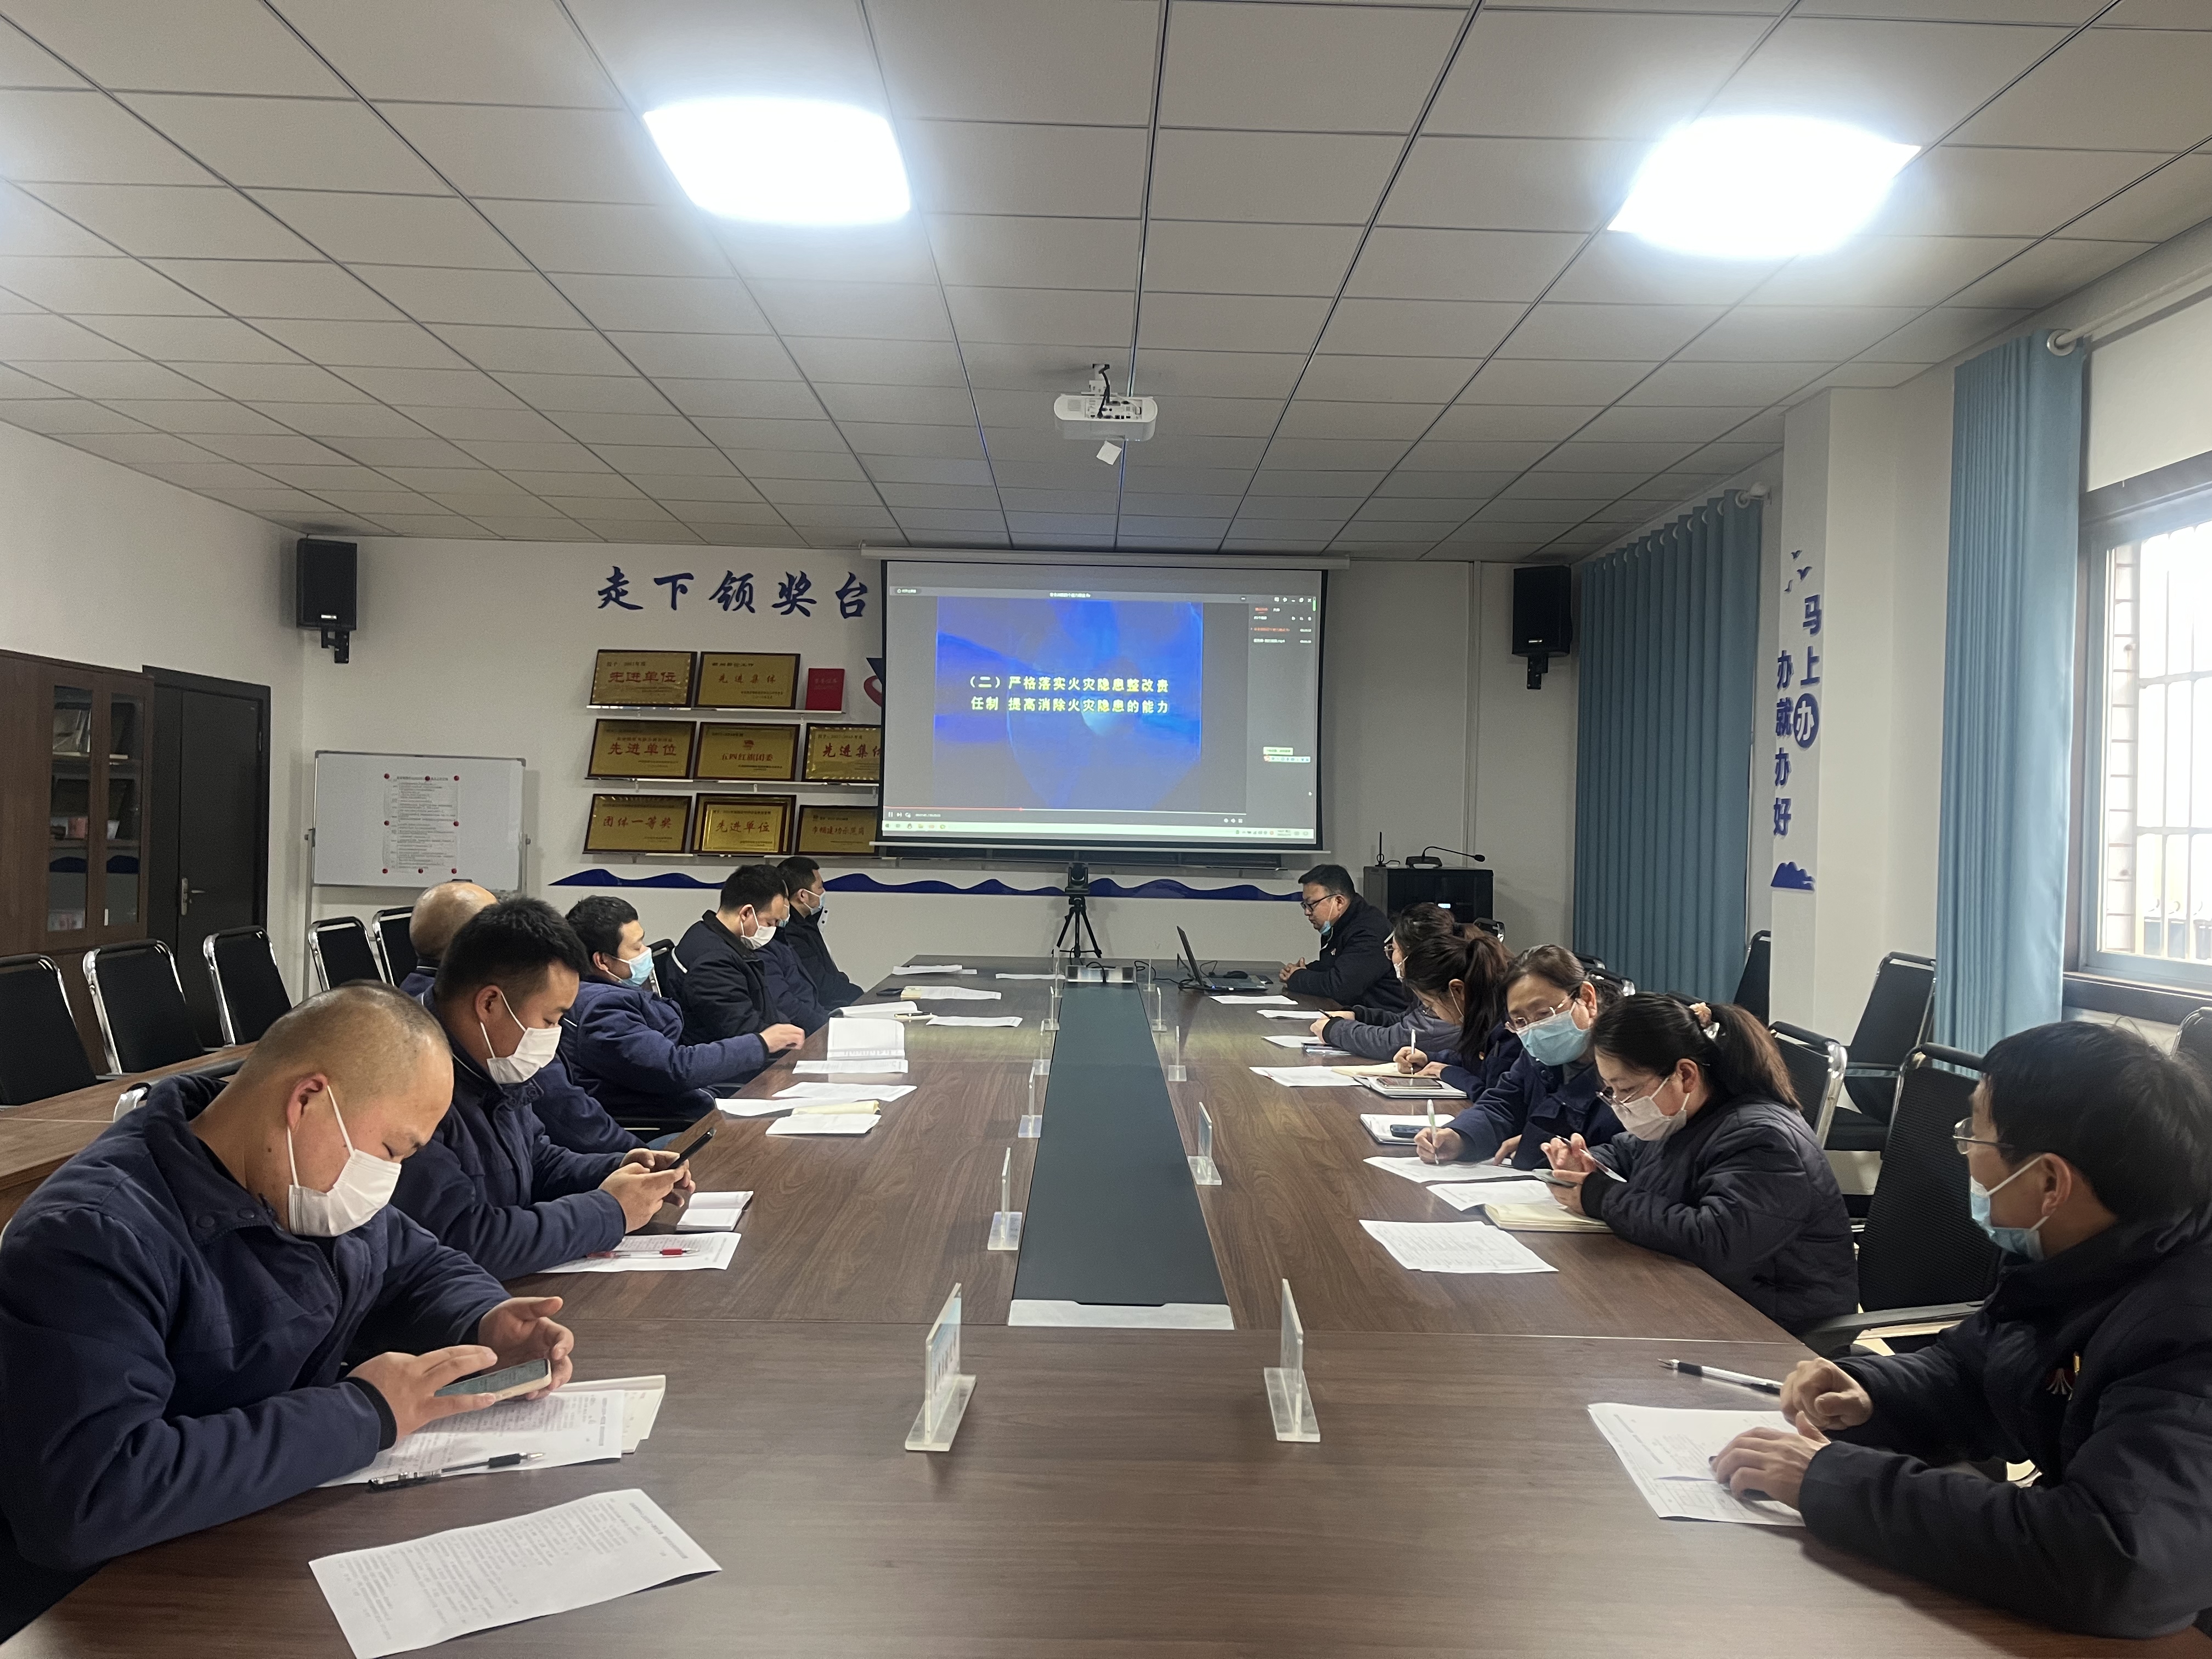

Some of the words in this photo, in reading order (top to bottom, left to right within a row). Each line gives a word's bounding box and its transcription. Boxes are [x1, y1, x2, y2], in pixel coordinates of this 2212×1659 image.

[597, 566, 869, 619] 走下领奖台
[1796, 594, 1822, 744] 马上办
[608, 671, 676, 683] 先进单位
[718, 673, 777, 684] 先进集体
[1008, 697, 1169, 714] 提高消除火灾隐患的能力
[608, 742, 676, 756] 先进单位
[1773, 650, 1794, 837] 办就办好
[603, 815, 672, 829] 团体一等奖
[715, 820, 770, 834] 先进单位
